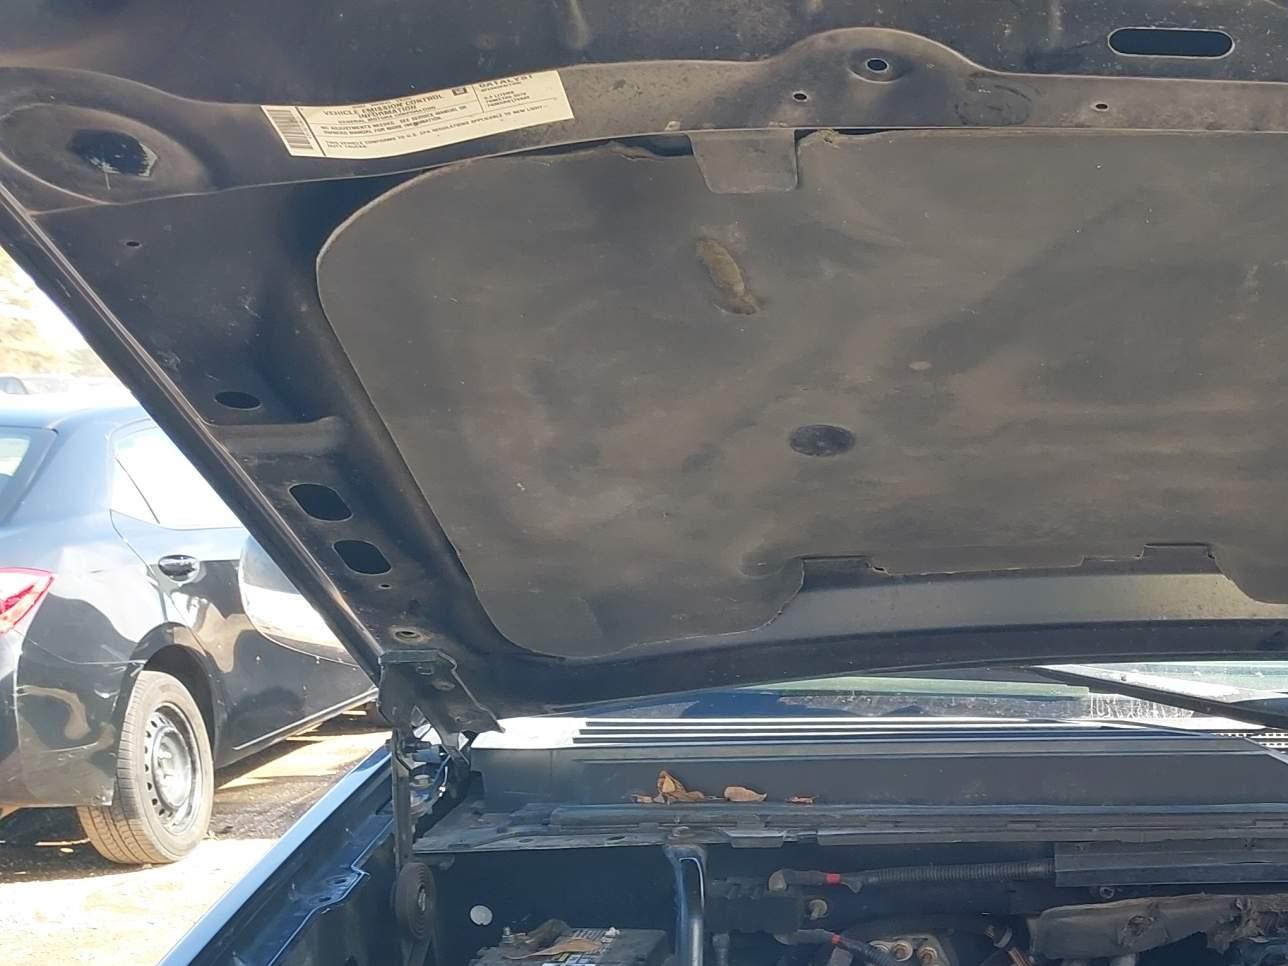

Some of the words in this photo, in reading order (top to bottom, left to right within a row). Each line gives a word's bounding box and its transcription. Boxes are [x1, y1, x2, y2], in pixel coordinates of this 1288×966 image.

[323, 109, 361, 117] VEHICLE
[361, 103, 402, 114] EMISSION
[404, 94, 443, 106] CONTROL
[358, 105, 418, 119] INFORMATION
